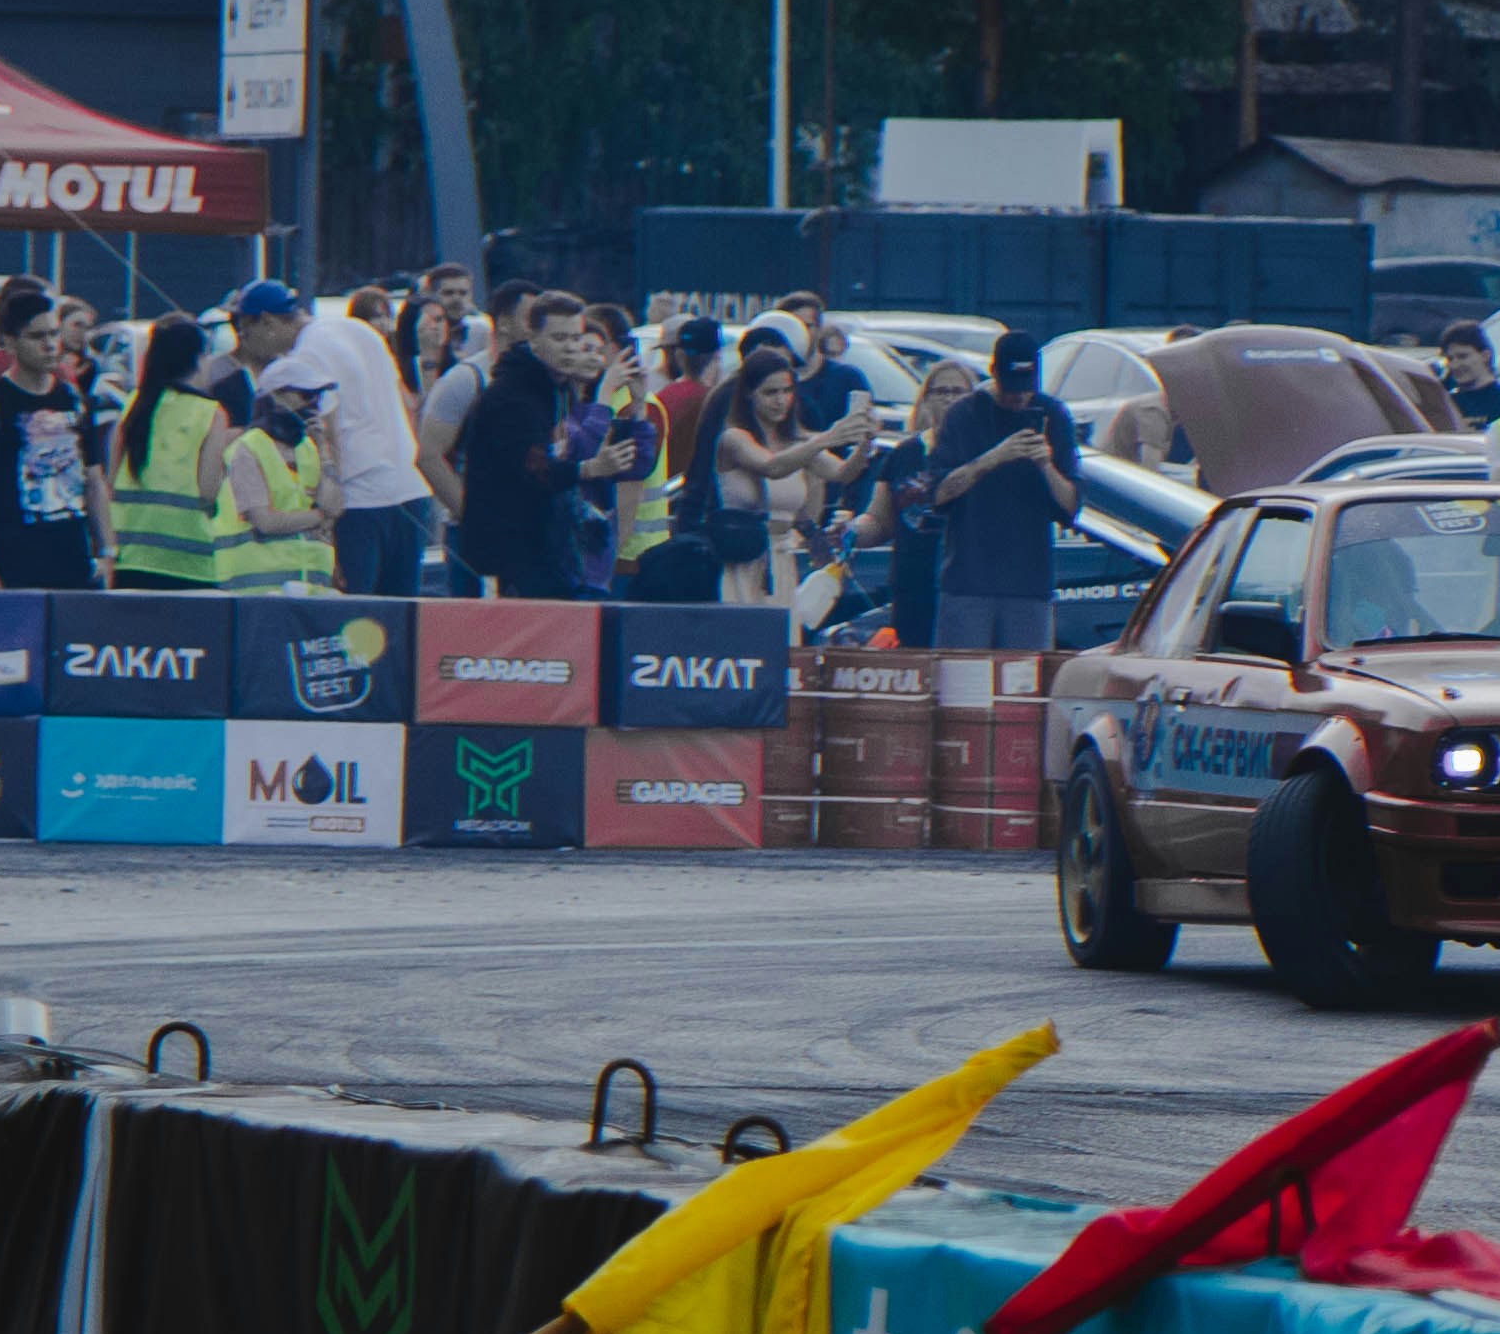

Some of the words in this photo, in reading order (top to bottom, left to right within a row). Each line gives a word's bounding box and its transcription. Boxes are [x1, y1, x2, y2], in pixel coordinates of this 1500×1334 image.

[64, 643, 206, 681] ZAKAT
[454, 657, 572, 685] GARAGE
[631, 654, 763, 691] ZAKAT
[306, 676, 352, 701] FEST
[831, 667, 922, 693] MOTUL
[630, 781, 745, 806] GARAGE
